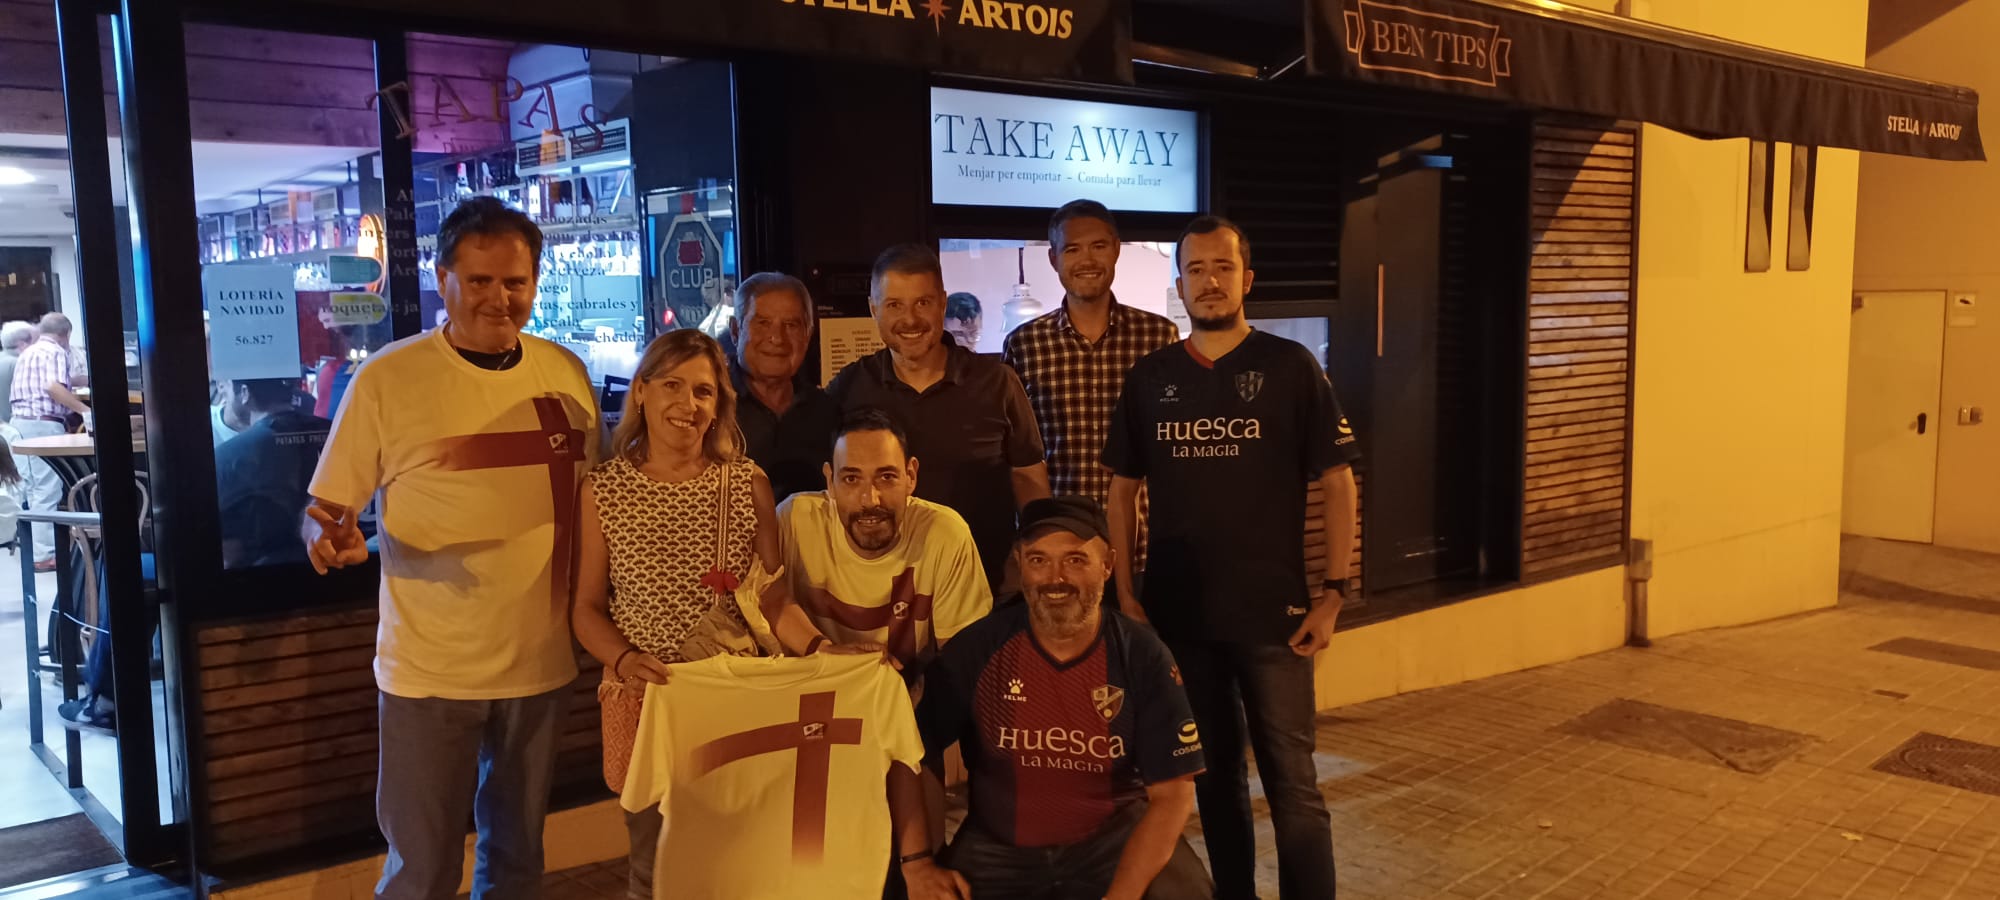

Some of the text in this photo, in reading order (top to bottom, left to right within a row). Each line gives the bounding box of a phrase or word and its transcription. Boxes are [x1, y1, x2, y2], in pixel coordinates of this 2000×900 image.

[783, 0, 1074, 39] LLA ARTOIS
[1371, 19, 1487, 69] BEN TIPS
[365, 75, 608, 151] TAPAS
[1887, 114, 1920, 136] STELLA
[934, 112, 1180, 168] TAKE AWAY
[957, 164, 1162, 187] Menjar per emportar Comida para llevar
[670, 267, 714, 289] CLUB
[219, 287, 284, 301] LOTERÍA
[566, 298, 626, 311] cabrales
[629, 301, 639, 312] y
[220, 304, 285, 316] NAVIDAD
[235, 333, 273, 346] 56.827
[594, 330, 645, 344] chedda
[1156, 416, 1262, 441] Huesca
[995, 726, 1127, 759] Huesca
